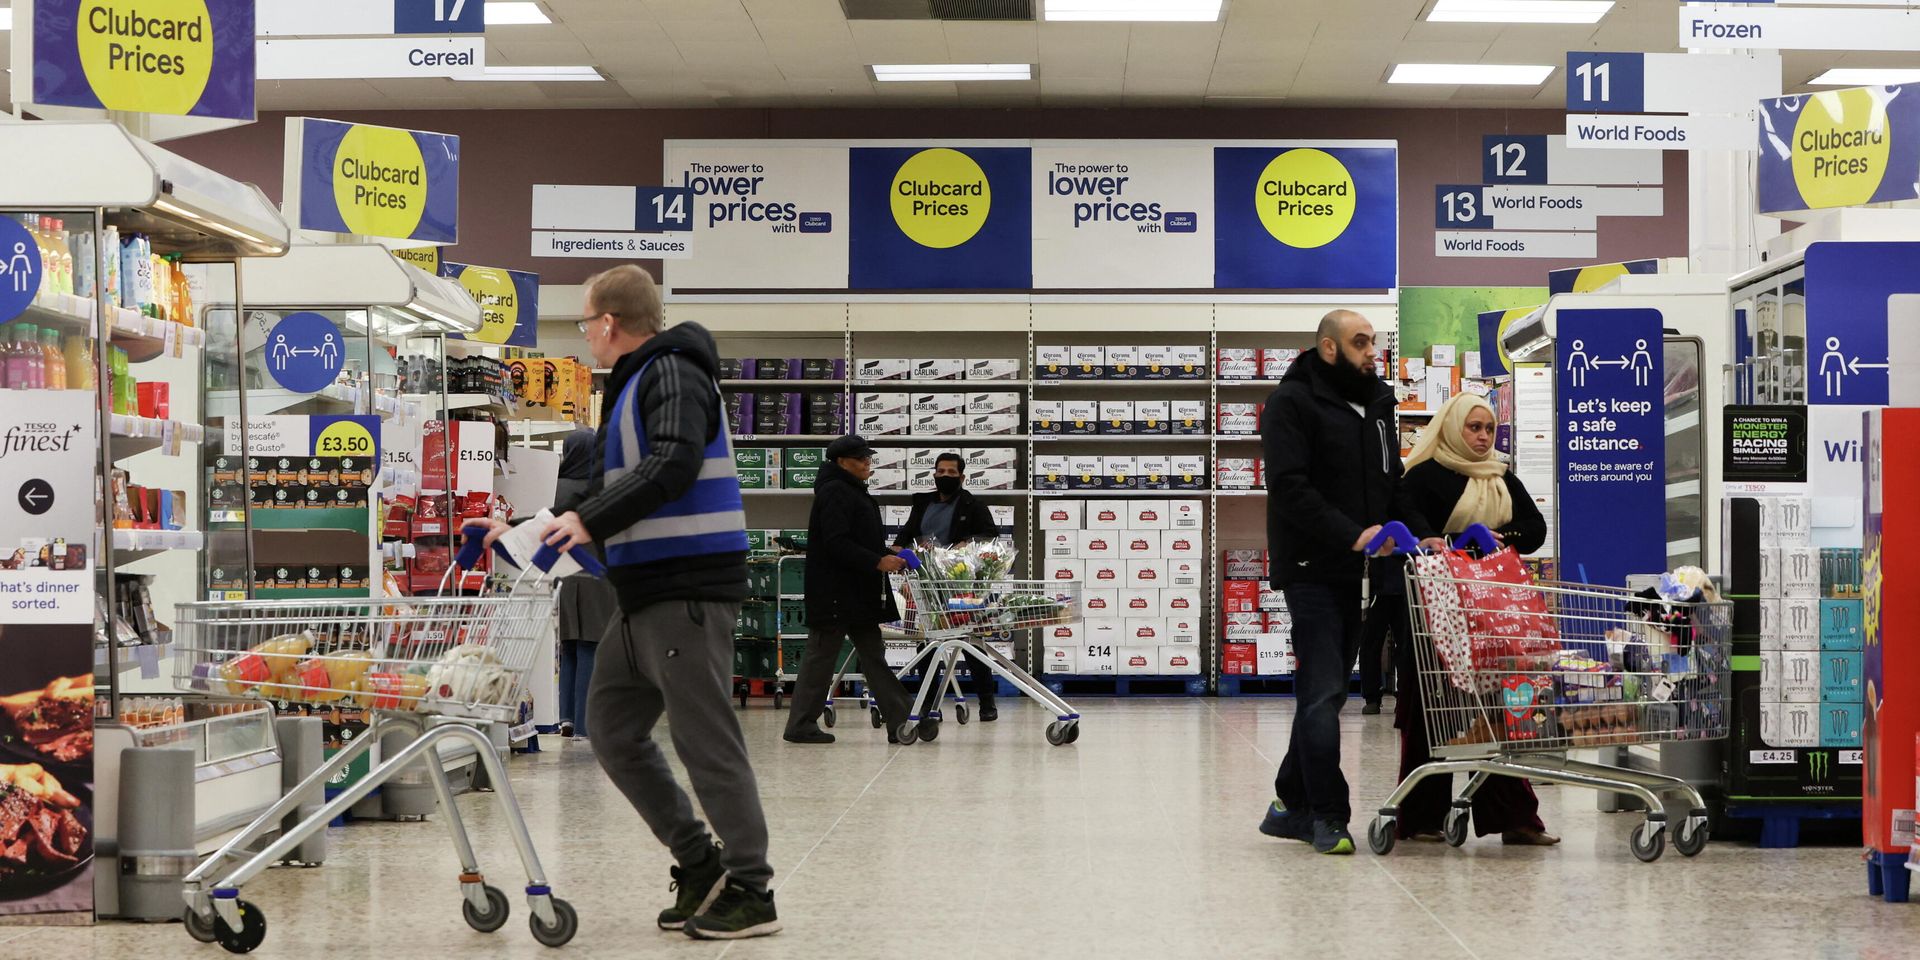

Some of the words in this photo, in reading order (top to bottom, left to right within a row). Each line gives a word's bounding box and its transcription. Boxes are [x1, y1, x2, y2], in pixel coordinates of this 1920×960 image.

[89, 6, 203, 43] Clubcard
[1692, 20, 1762, 39] Frozen
[108, 43, 185, 76] Prices
[408, 48, 474, 67] Cereal
[1576, 62, 1610, 102] 11
[1578, 125, 1629, 141] World
[1634, 126, 1686, 142] Foods
[1800, 129, 1883, 152] Clubcard
[1490, 143, 1527, 176] 12
[1813, 156, 1868, 178] Prices
[341, 157, 420, 186] Clubcard
[690, 163, 712, 173] The
[713, 165, 750, 176] power
[751, 164, 764, 173] to
[1055, 163, 1076, 173] The
[1078, 165, 1114, 176] power
[1116, 164, 1128, 173] to
[684, 171, 764, 196] lower
[899, 181, 982, 197] Clubcard
[1049, 171, 1129, 196] lower
[1264, 181, 1347, 196] Clubcard
[354, 184, 407, 210] Prices
[1492, 196, 1535, 209] World
[1539, 196, 1583, 209] Foods
[651, 194, 687, 224] 14
[709, 197, 797, 228] prices
[913, 201, 968, 216] Prices
[1074, 197, 1161, 228] prices
[1278, 201, 1334, 216] Prices
[1442, 192, 1476, 222] 13
[772, 223, 796, 233] with
[1137, 223, 1161, 233] with
[552, 238, 624, 253] Ingredients
[627, 239, 637, 251] &
[639, 239, 685, 252] Sauces
[1444, 239, 1482, 251] World
[1486, 240, 1525, 251] Foods
[914, 403, 938, 411] CARLING
[1611, 398, 1651, 416] keep
[1568, 420, 1578, 432] a
[1582, 417, 1617, 432] safe
[0, 426, 73, 459] finest
[1733, 431, 1787, 439] ENERGY
[322, 437, 368, 452] £3.50
[1733, 439, 1788, 447] RACING
[460, 450, 493, 461] £1.50
[737, 453, 760, 461] Carlsberg
[793, 453, 818, 461] Carlsberg
[1568, 462, 1598, 471] Please
[1600, 462, 1612, 471] be
[1614, 463, 1642, 471] aware
[1644, 461, 1654, 471] of
[1568, 473, 1599, 482] others
[1600, 472, 1633, 481] around
[1635, 474, 1652, 483] you
[0, 581, 32, 593] hat’s
[36, 580, 80, 593] dinner
[12, 597, 60, 609] sorted.
[1088, 645, 1111, 657] £14
[1763, 752, 1793, 760] £4.25
